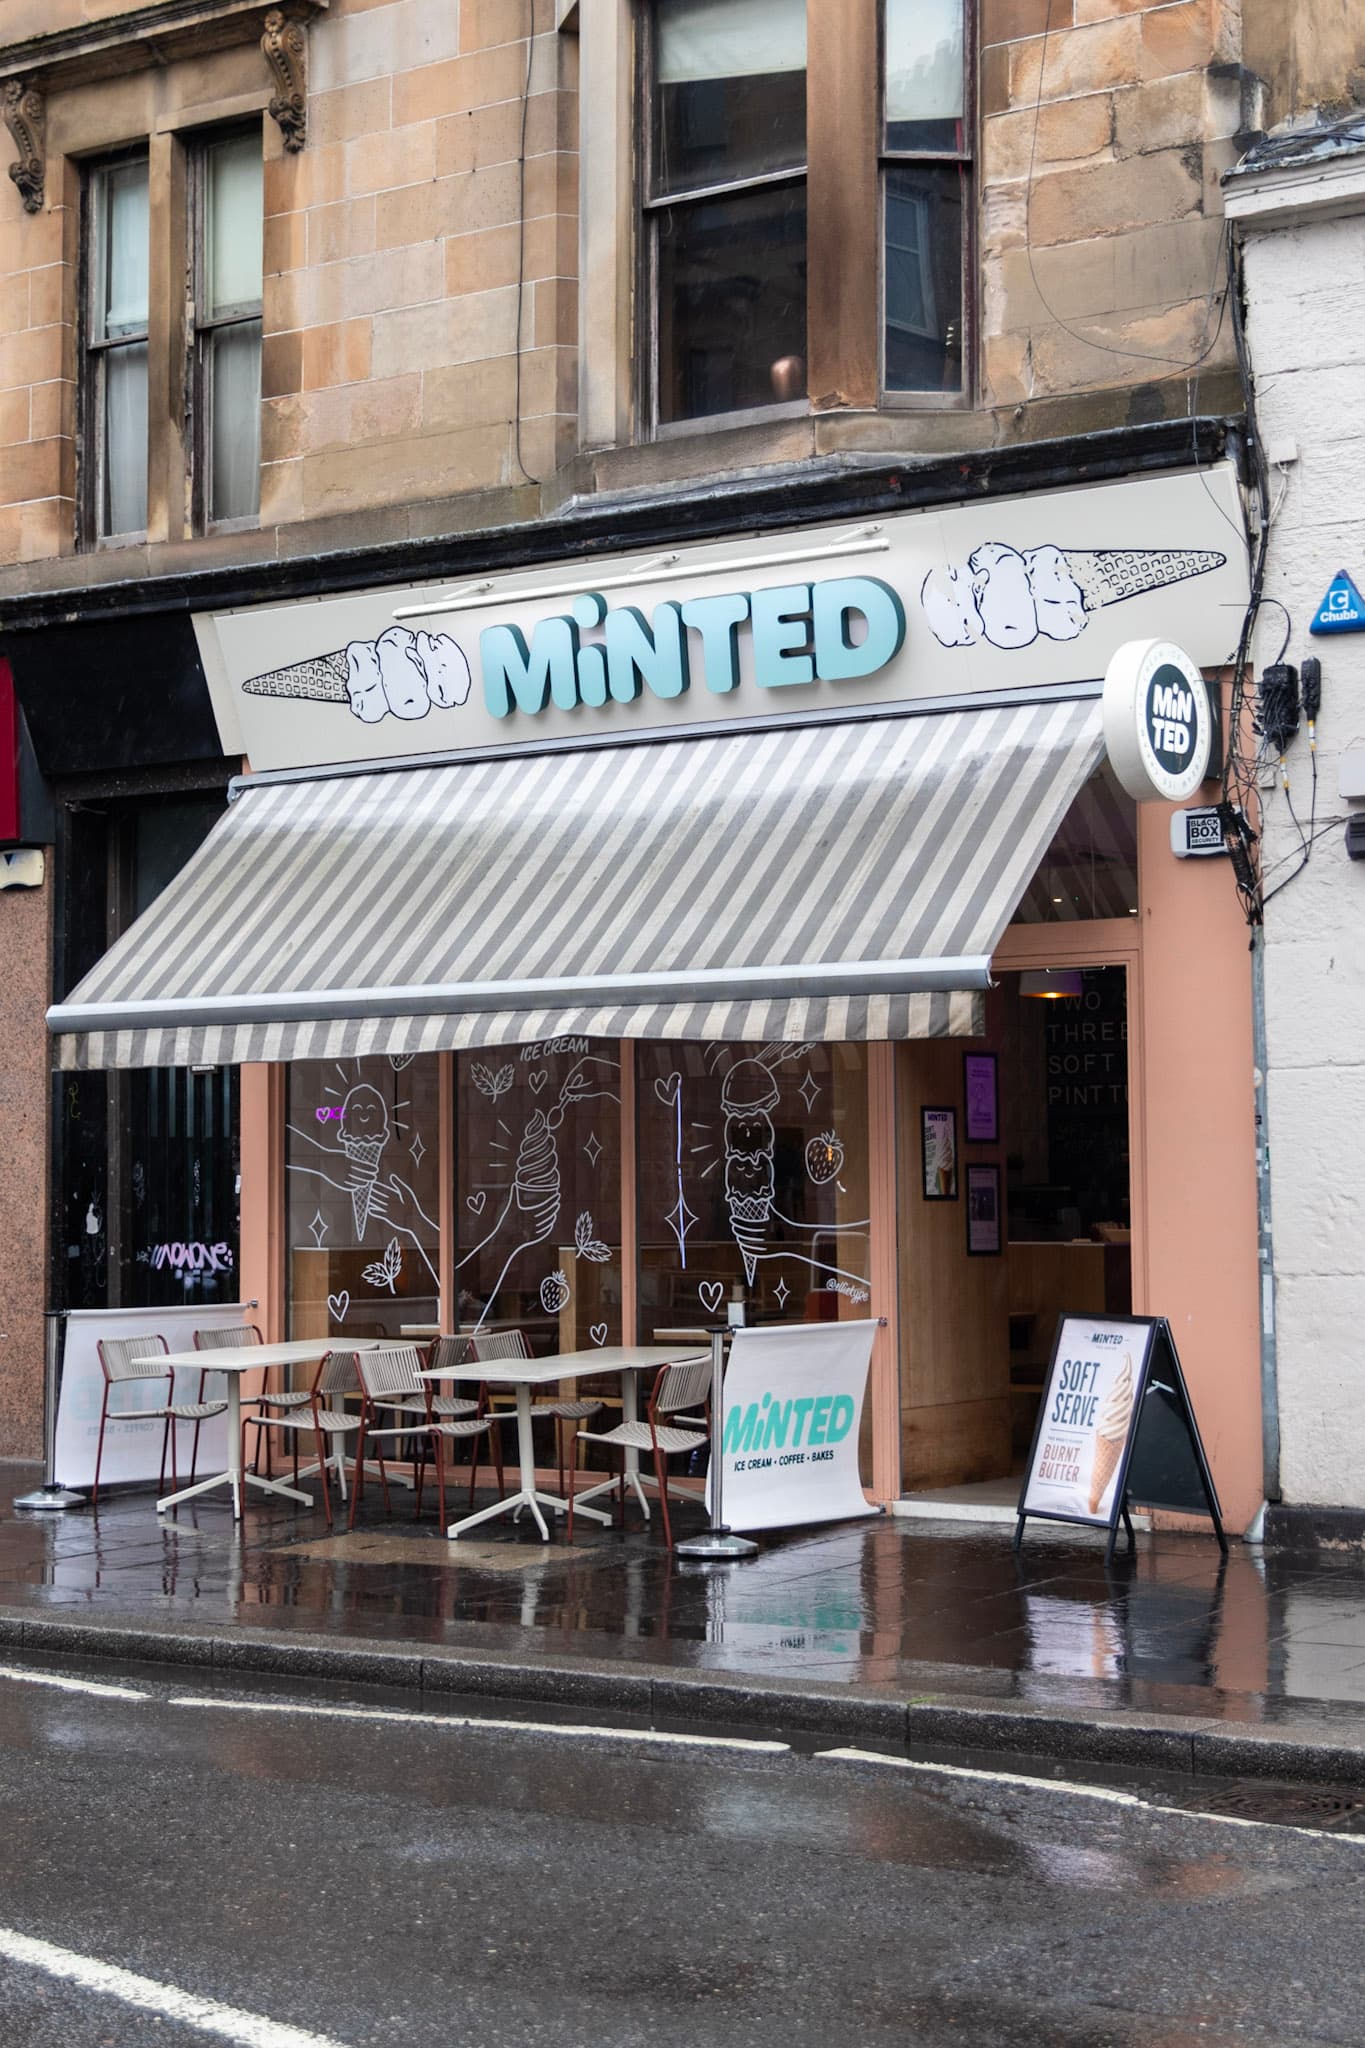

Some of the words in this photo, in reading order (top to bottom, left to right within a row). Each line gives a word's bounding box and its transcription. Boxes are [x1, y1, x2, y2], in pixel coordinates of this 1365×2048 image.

[1320, 609, 1358, 623] Chubb
[1152, 717, 1190, 754] TED
[1190, 819, 1218, 827] BLACK
[1191, 826, 1219, 838] BOX
[520, 1043, 542, 1062] ICE
[543, 1037, 589, 1056] CREAM
[1048, 1053, 1116, 1074] SOFT
[1049, 1086, 1104, 1105] PINT
[1059, 1359, 1100, 1393] SOFT
[1051, 1392, 1099, 1427] SERVE
[734, 1460, 746, 1472] ICE
[748, 1457, 772, 1470] CREAM
[779, 1454, 805, 1466] COFFEE
[811, 1450, 834, 1462] BAKES
[1043, 1443, 1081, 1462] BURNT
[1038, 1463, 1080, 1483] BUTTER
